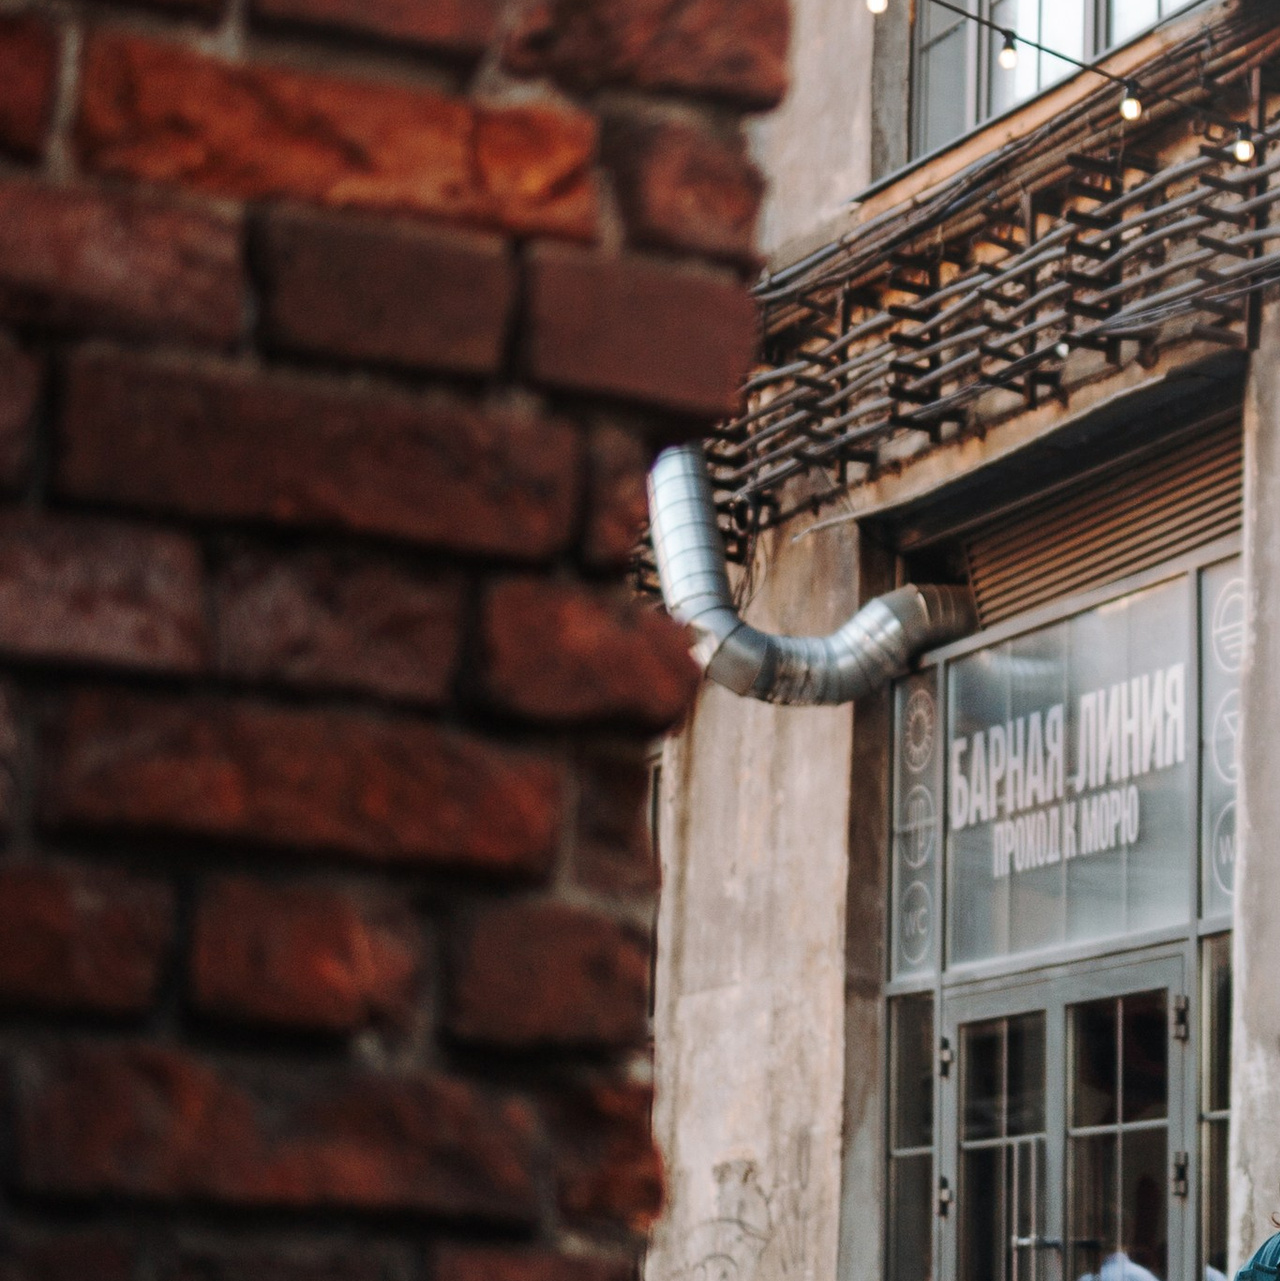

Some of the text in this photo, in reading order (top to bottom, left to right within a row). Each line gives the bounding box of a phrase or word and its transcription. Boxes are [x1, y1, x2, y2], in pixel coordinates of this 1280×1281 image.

[951, 663, 1185, 831] БАРНАЯ ЛИНИЯ
[994, 783, 1140, 878] ПРОХОД К МОРЮ
